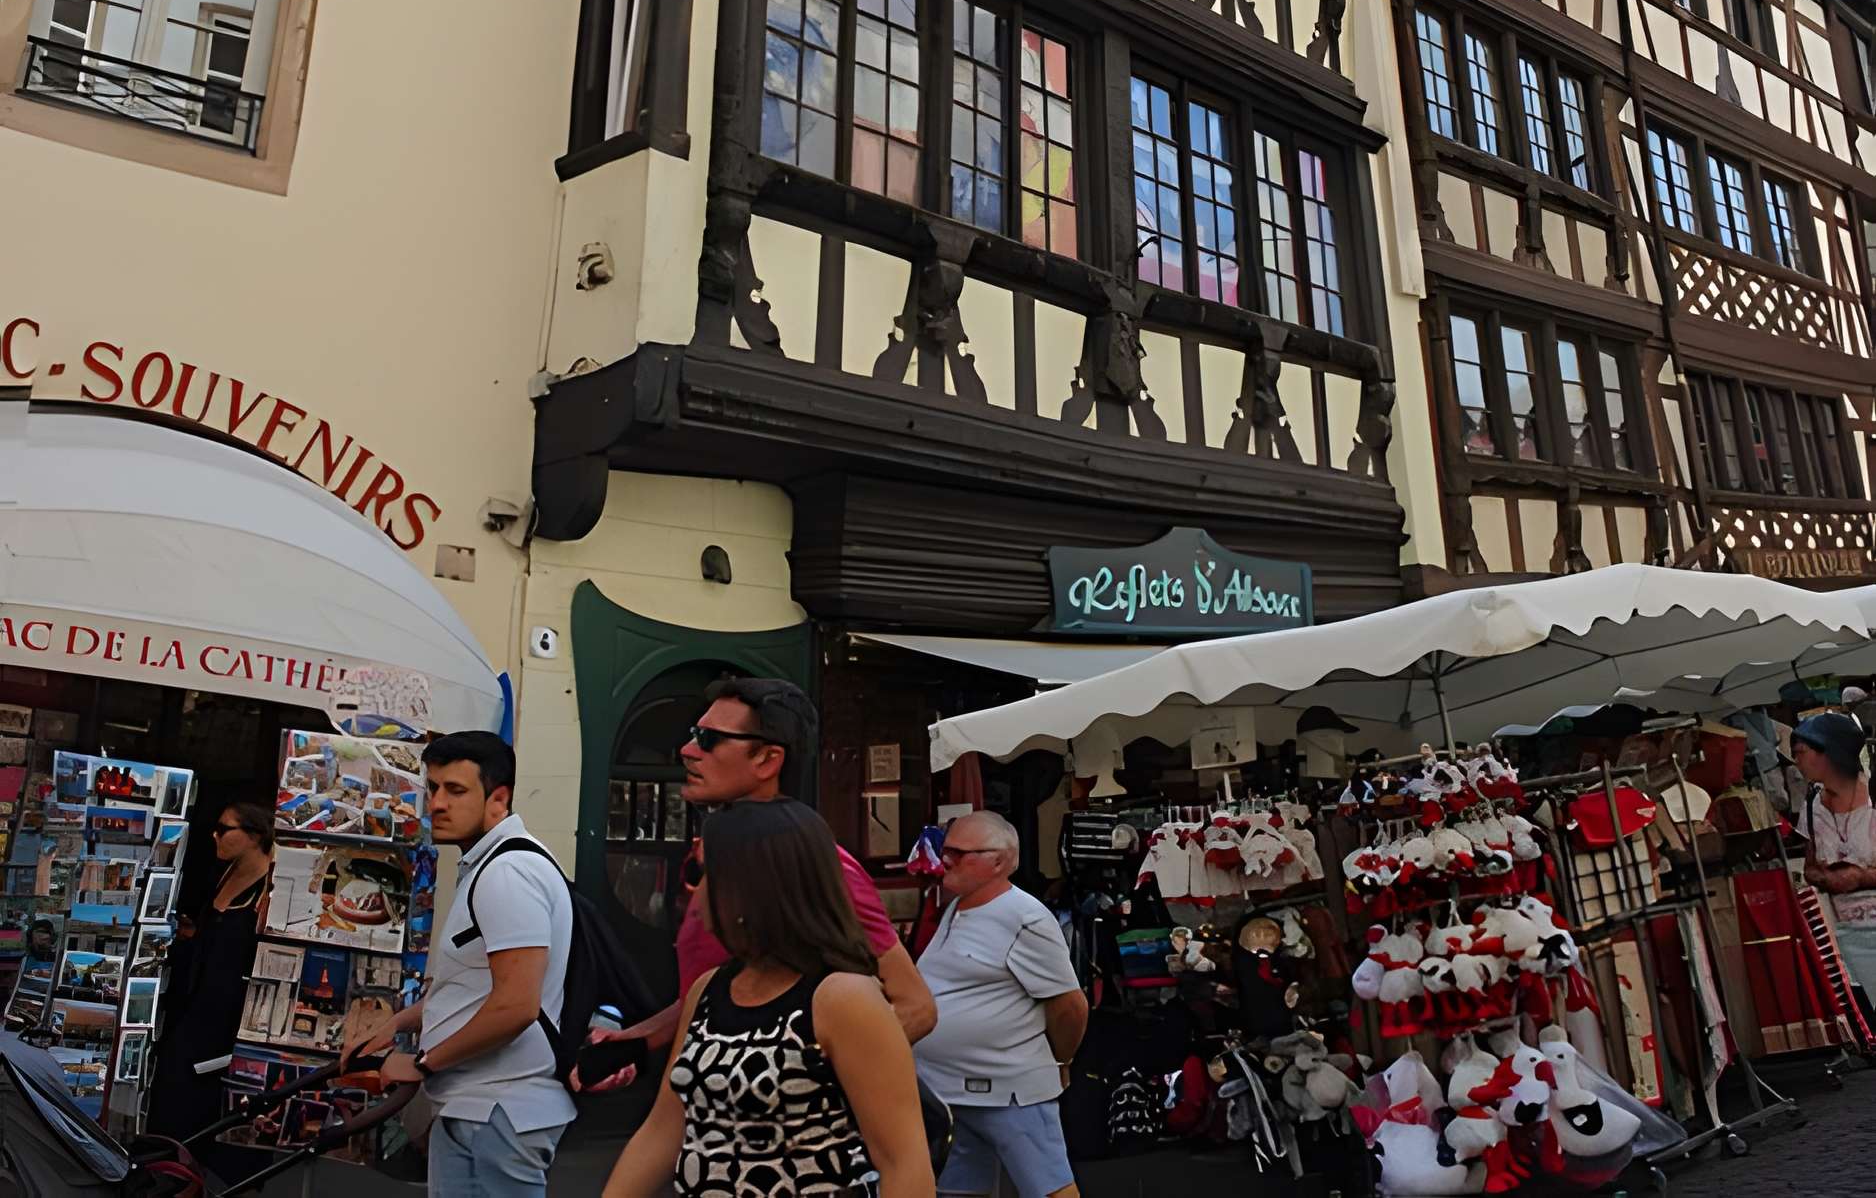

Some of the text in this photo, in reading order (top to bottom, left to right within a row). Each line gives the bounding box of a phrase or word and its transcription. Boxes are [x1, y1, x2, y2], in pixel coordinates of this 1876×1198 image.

[0, 317, 40, 379] C
[80, 341, 442, 551] SOUVENIRS
[1068, 564, 1185, 622] Reflets
[66, 625, 126, 662] DE
[139, 635, 186, 670] LA
